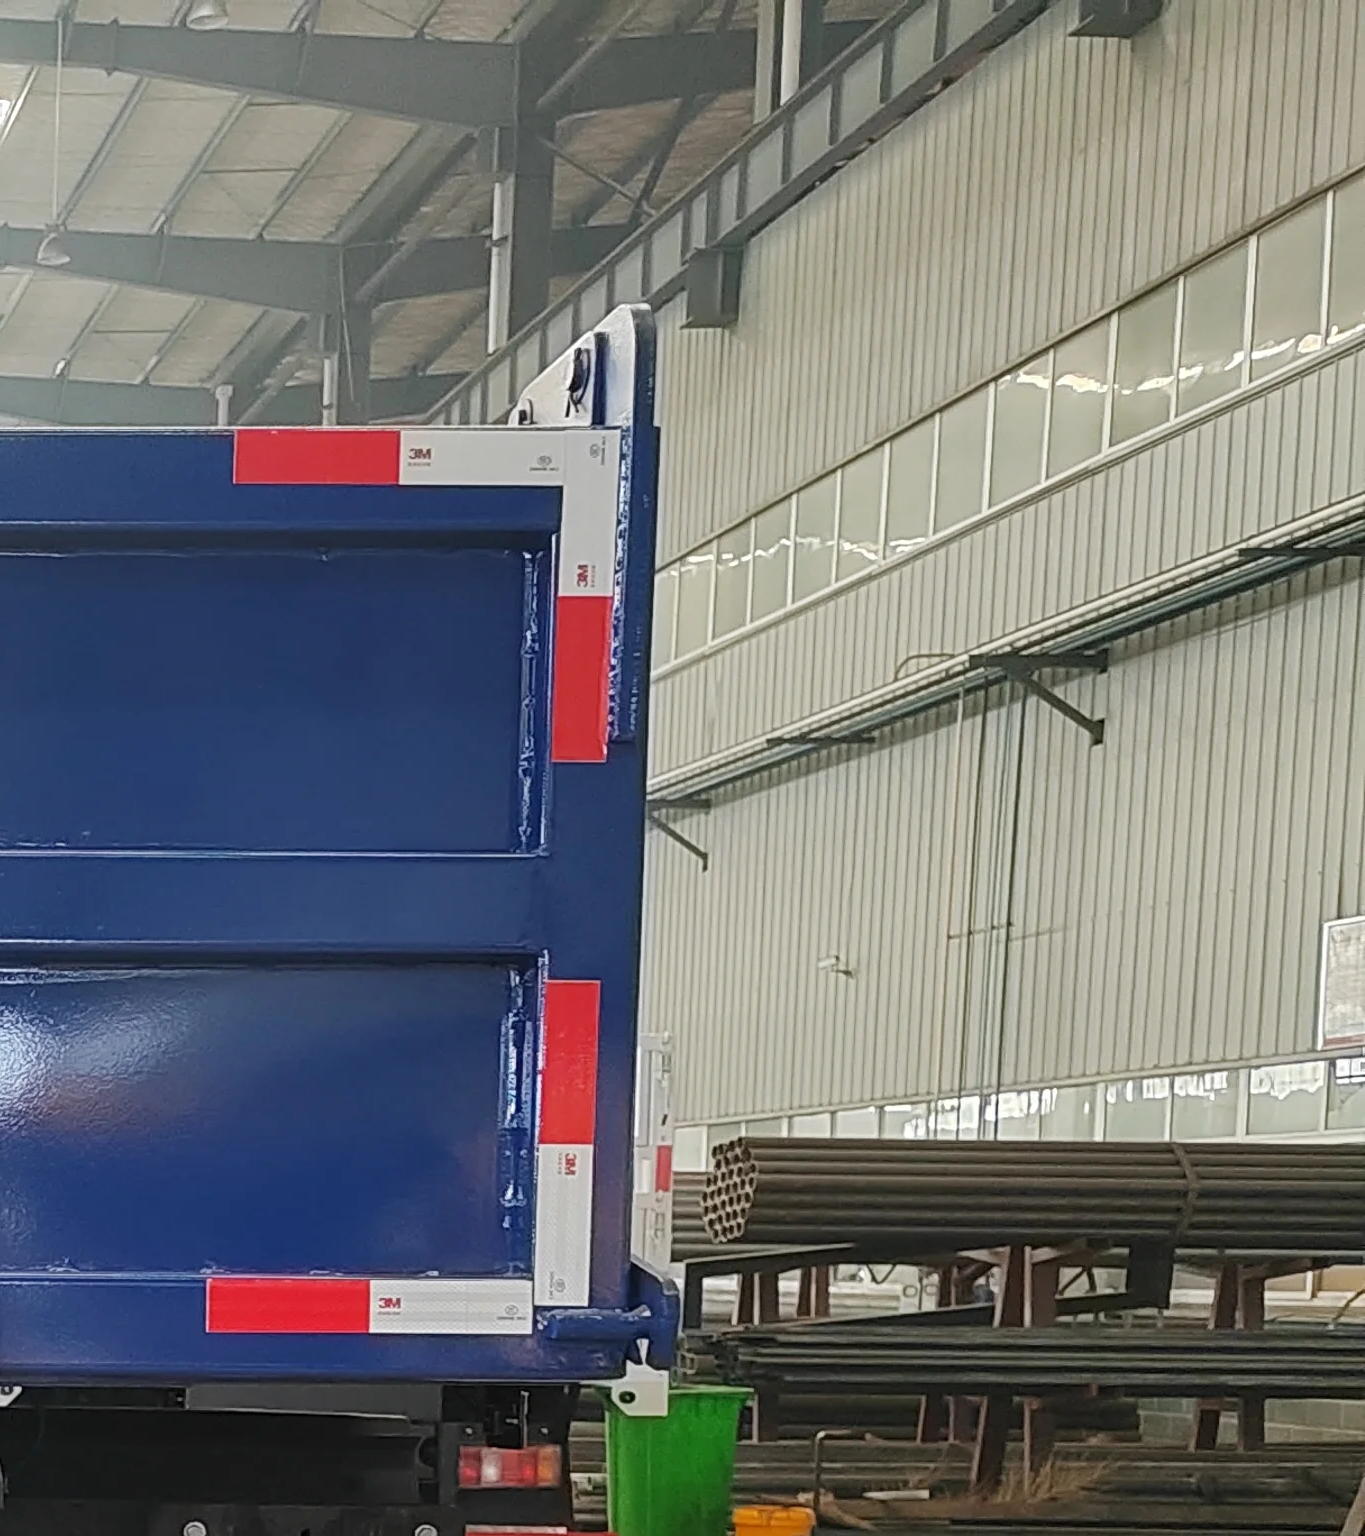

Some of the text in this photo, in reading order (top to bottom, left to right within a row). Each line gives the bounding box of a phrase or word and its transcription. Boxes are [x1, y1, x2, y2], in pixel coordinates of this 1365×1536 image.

[407, 448, 432, 460] 3M
[576, 563, 590, 588] 3M
[564, 1152, 577, 1176] 3M
[378, 1297, 402, 1309] 3M
